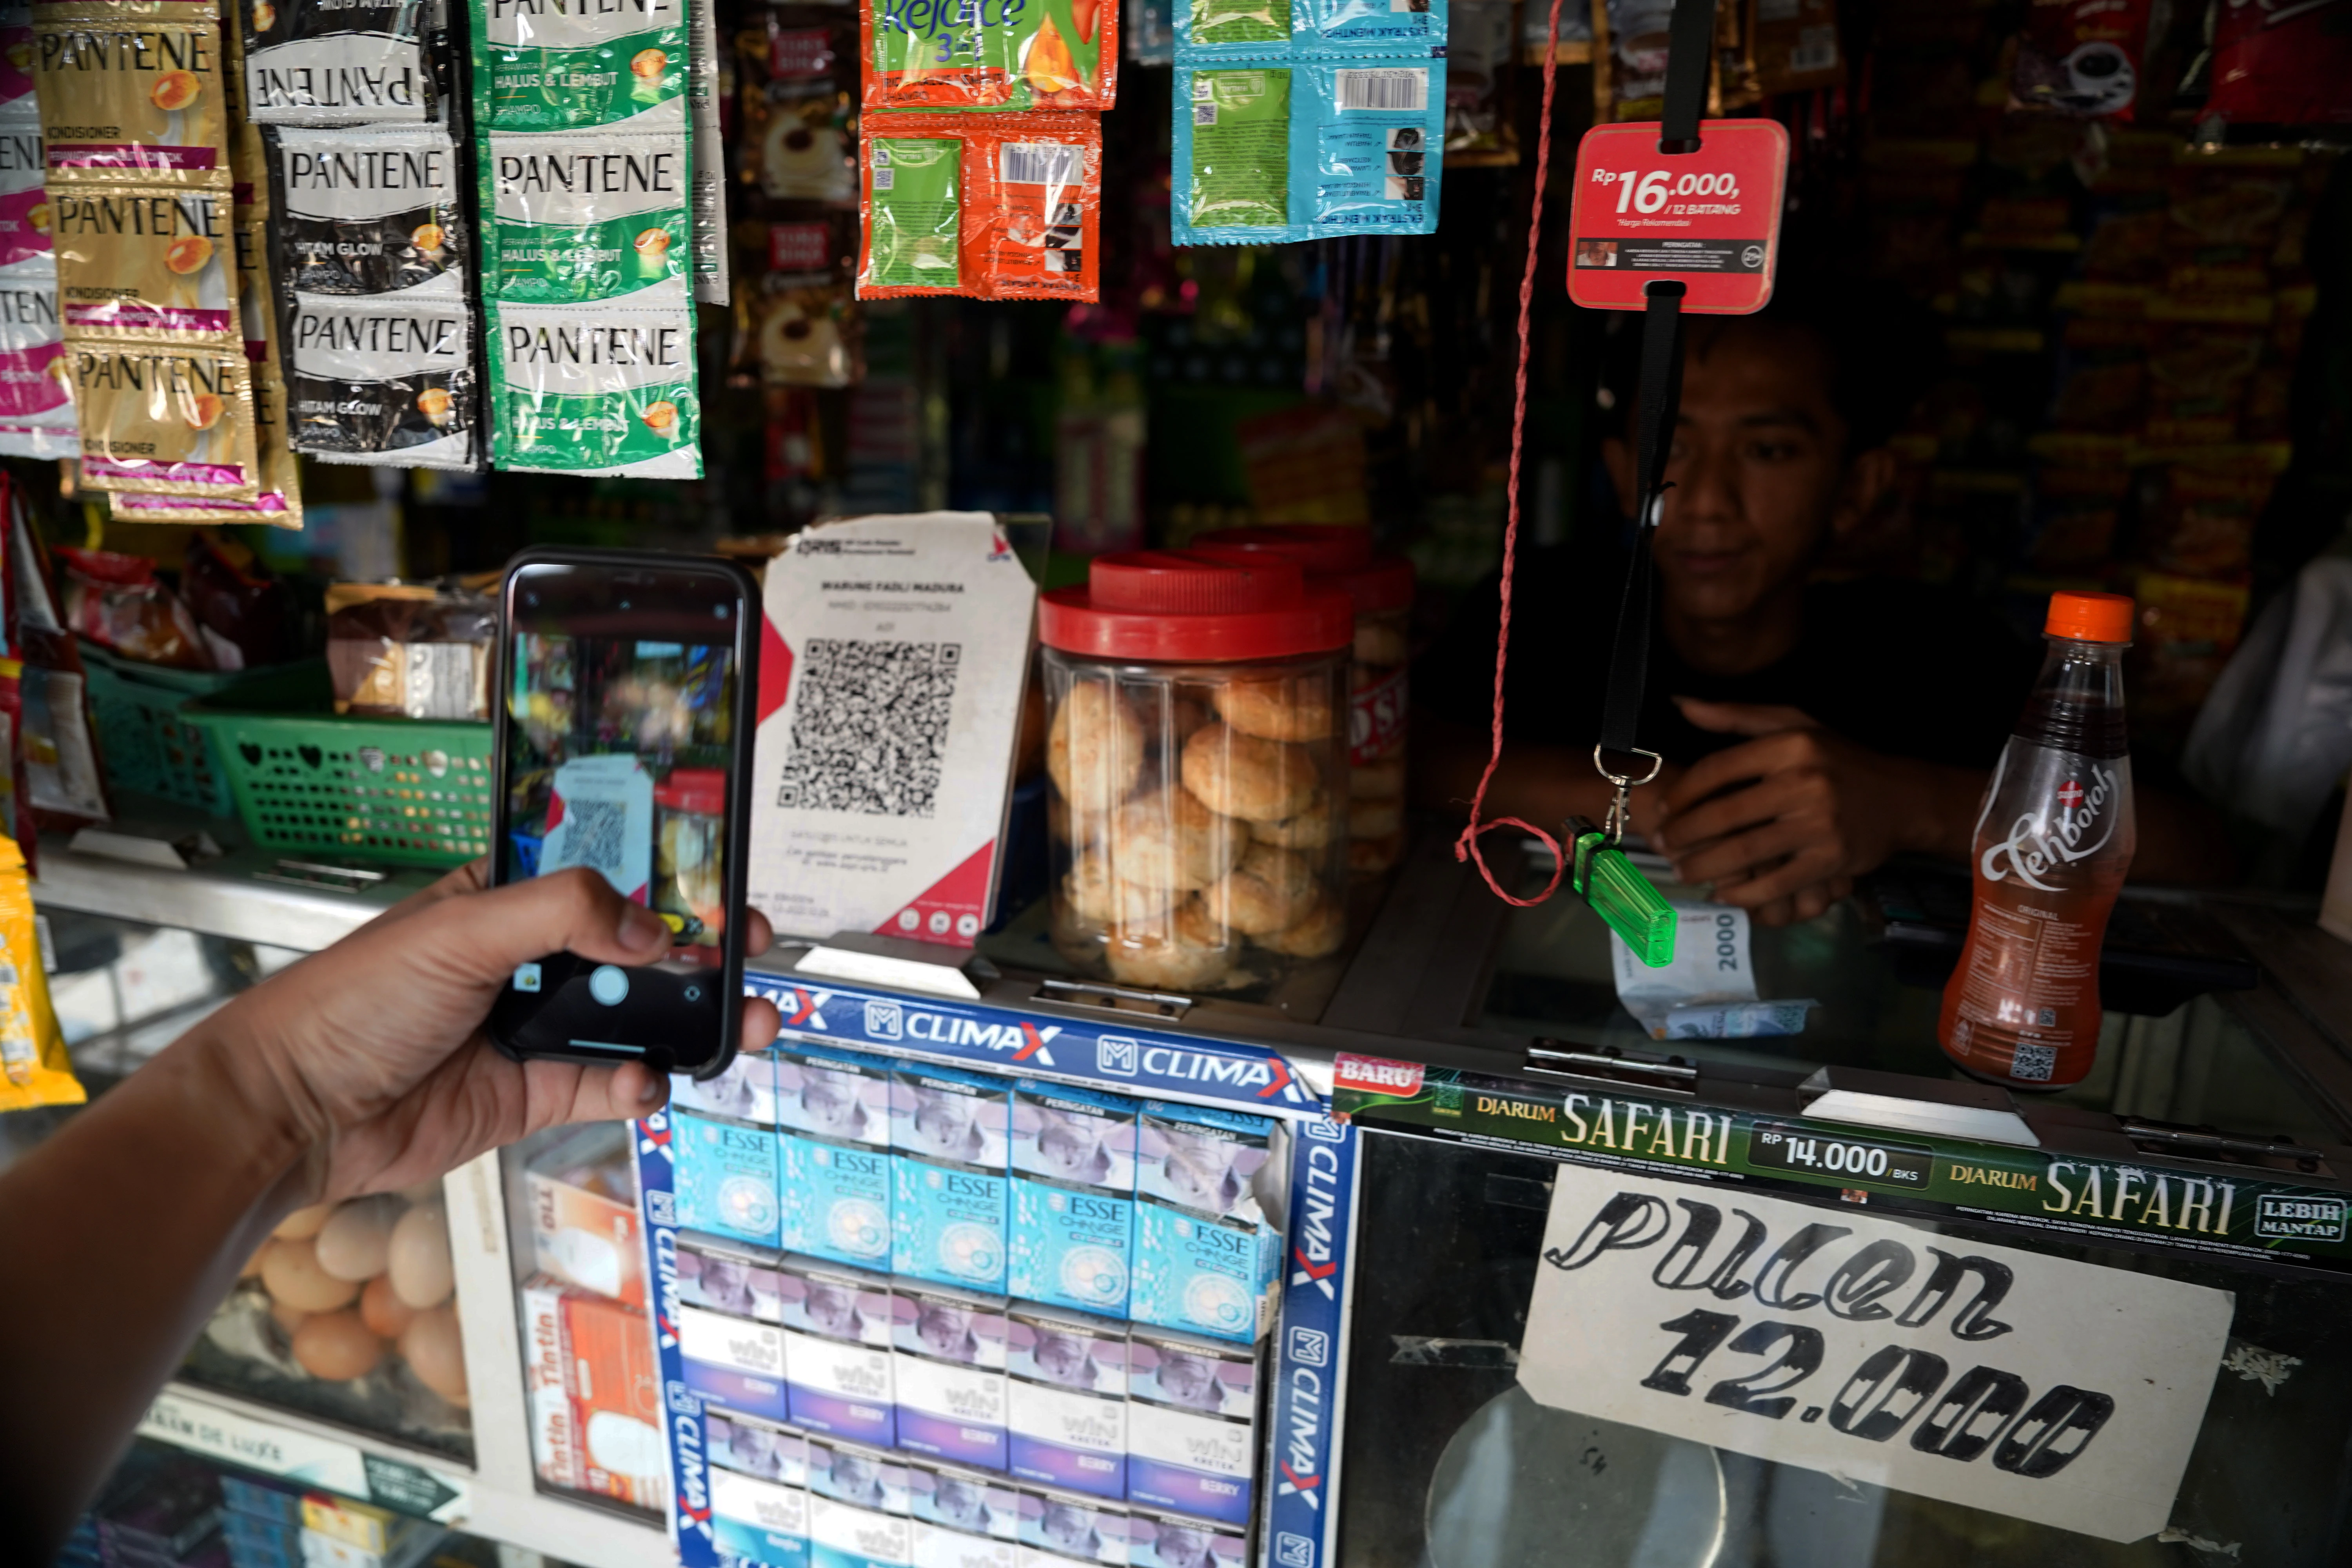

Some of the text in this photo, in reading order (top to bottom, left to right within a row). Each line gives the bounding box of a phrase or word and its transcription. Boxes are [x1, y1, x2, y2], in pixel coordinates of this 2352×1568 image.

[42, 32, 212, 73] PANTENE
[935, 33, 953, 62] 3
[256, 67, 415, 107] PANTENE
[494, 71, 619, 89] HALUS & LEMBUT
[291, 151, 445, 189] PANTENE
[500, 154, 673, 194] PANTENE
[1591, 169, 1617, 186] Rp
[58, 196, 224, 238] PANTENE
[1688, 204, 1741, 215] BATANG
[336, 243, 383, 256] GLOW
[501, 249, 546, 262] HALUS
[299, 315, 457, 355] PANTENE
[509, 326, 679, 366] PANTENE
[79, 352, 234, 395] PANTENE
[298, 400, 336, 413] HITAM
[821, 581, 873, 592] WARUNG
[2017, 904, 2059, 921] ORIGINAL
[1715, 913, 1738, 972] 2000
[906, 1013, 1063, 1067] CLIMAX
[1142, 1047, 1303, 1104] CLIMAX
[1340, 1060, 1414, 1089] BARU
[1044, 1097, 1105, 1117] PERINGATAN
[723, 1129, 771, 1152] ESSE
[1175, 1122, 1237, 1141] PERINGATAN
[1476, 1093, 1733, 1165] DJARUM SAFARI
[834, 1152, 884, 1175] ESSE
[1761, 1132, 1782, 1145] RP
[1785, 1136, 1888, 1177] 14.000
[947, 1174, 999, 1199] ESSE
[1949, 1161, 2237, 1235] DJARUM SAFARI
[1071, 1196, 1126, 1223] ESSE
[1293, 1145, 1339, 1301] CLIMAX
[2263, 1201, 2341, 1221] LEBIH
[1196, 1224, 1250, 1256] ESSE
[2262, 1220, 2341, 1238] MANTAP
[1640, 1308, 2115, 1479] 12.000
[1278, 1367, 1321, 1511] CLIMAX
[674, 1415, 713, 1541] CLIMAX
